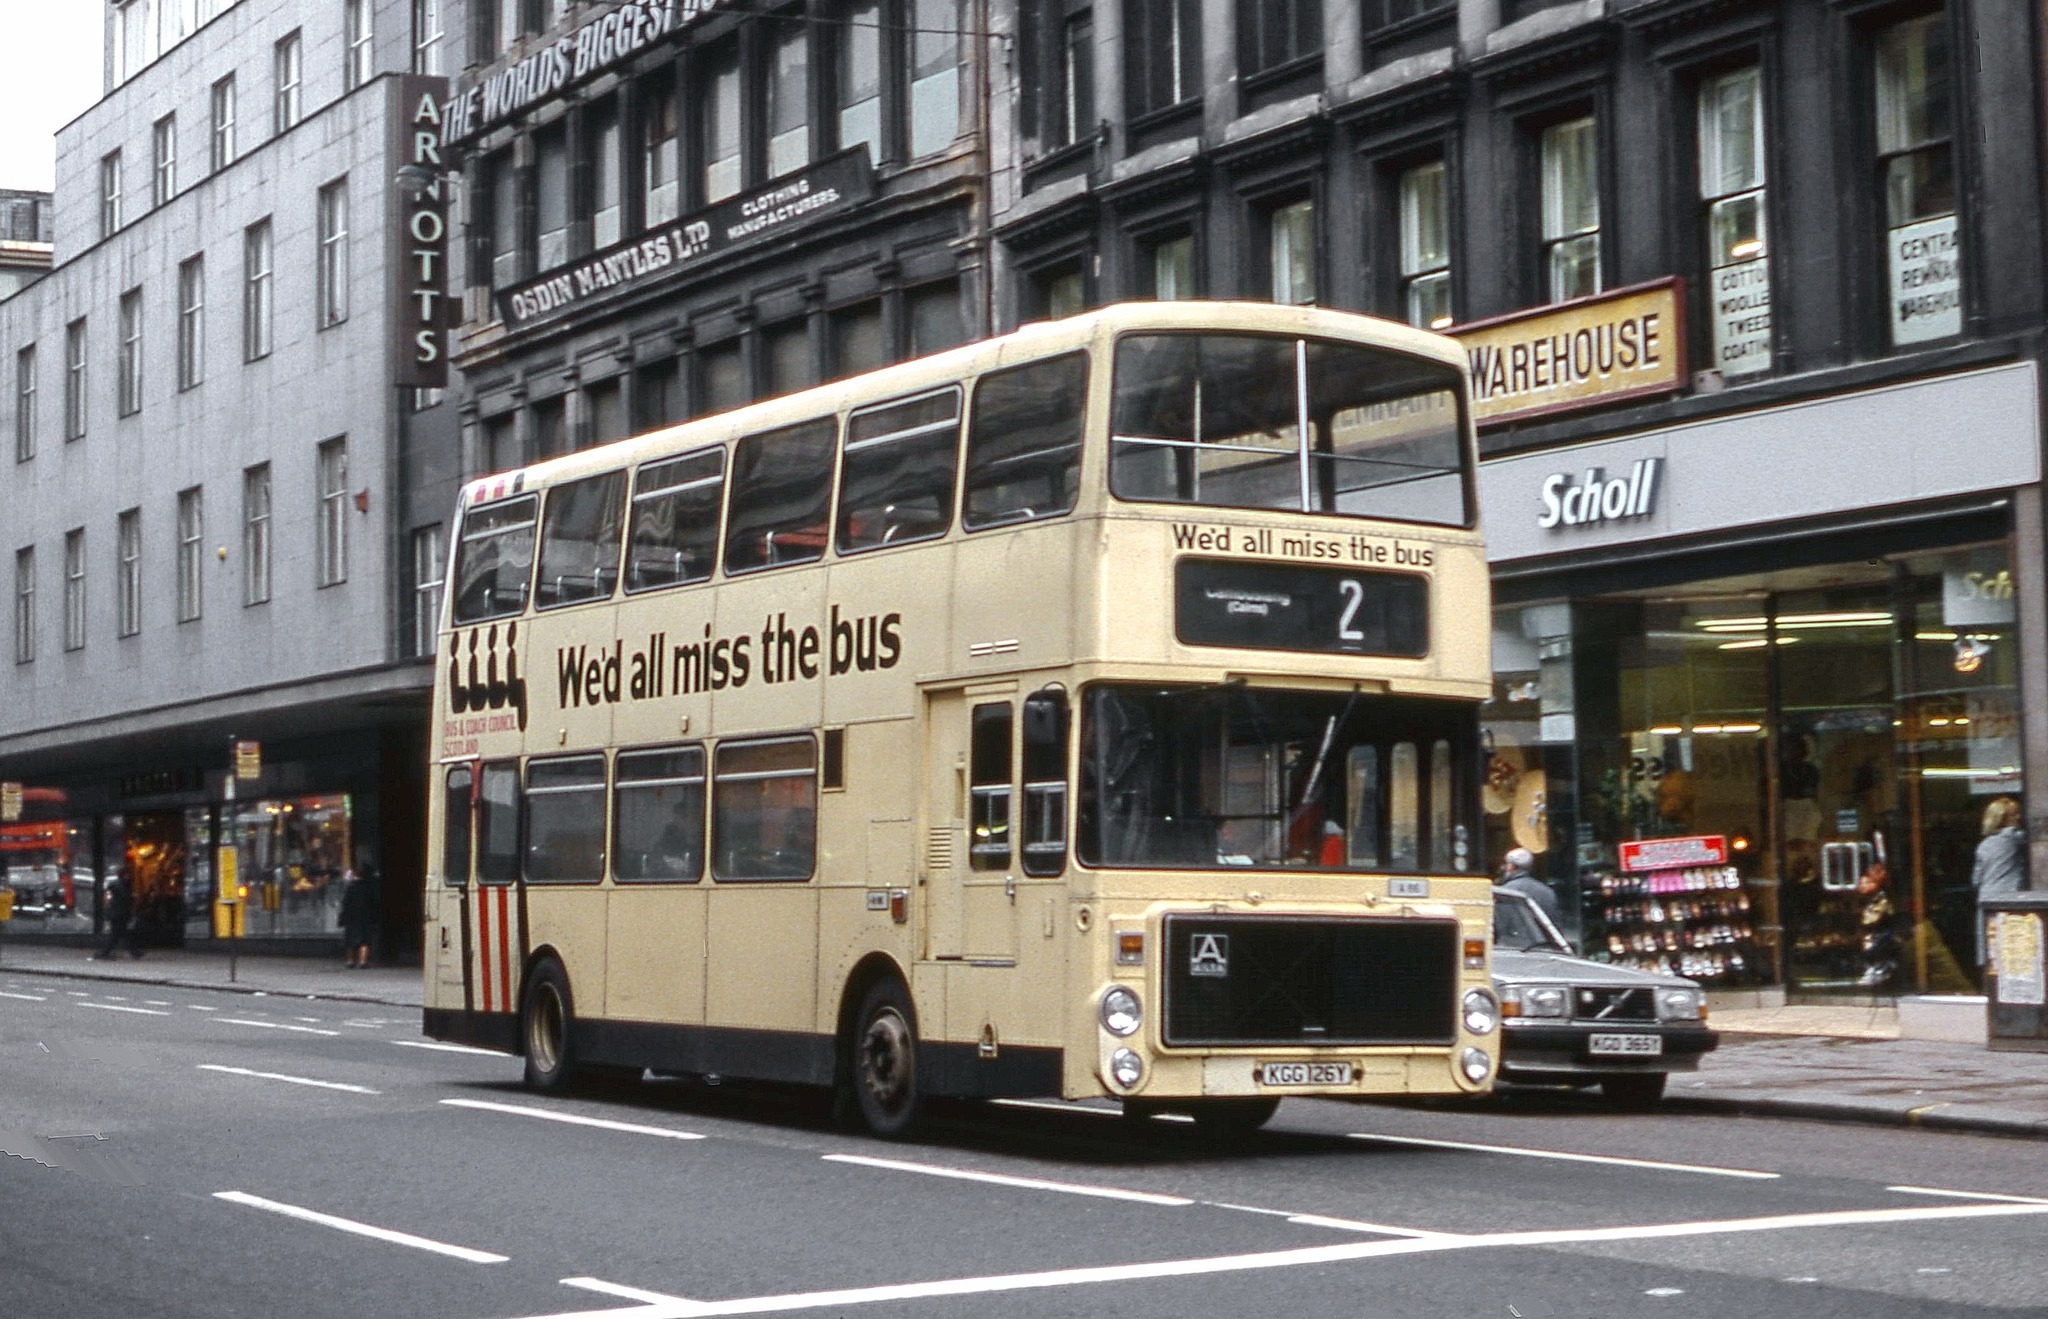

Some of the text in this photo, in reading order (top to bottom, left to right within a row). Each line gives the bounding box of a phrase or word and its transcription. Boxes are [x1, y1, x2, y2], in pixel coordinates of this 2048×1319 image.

[440, 86, 479, 147] THE
[741, 179, 810, 217] CLOTHING
[511, 274, 574, 320] OSDIN
[574, 236, 672, 296] MANTLES
[1467, 312, 1660, 401] WAREHOUSE
[1538, 458, 1660, 528] Scholl
[1172, 523, 1433, 567] We'd all miss the bus
[1338, 579, 1364, 640] 2
[558, 603, 902, 709] We'd all miss the bus
